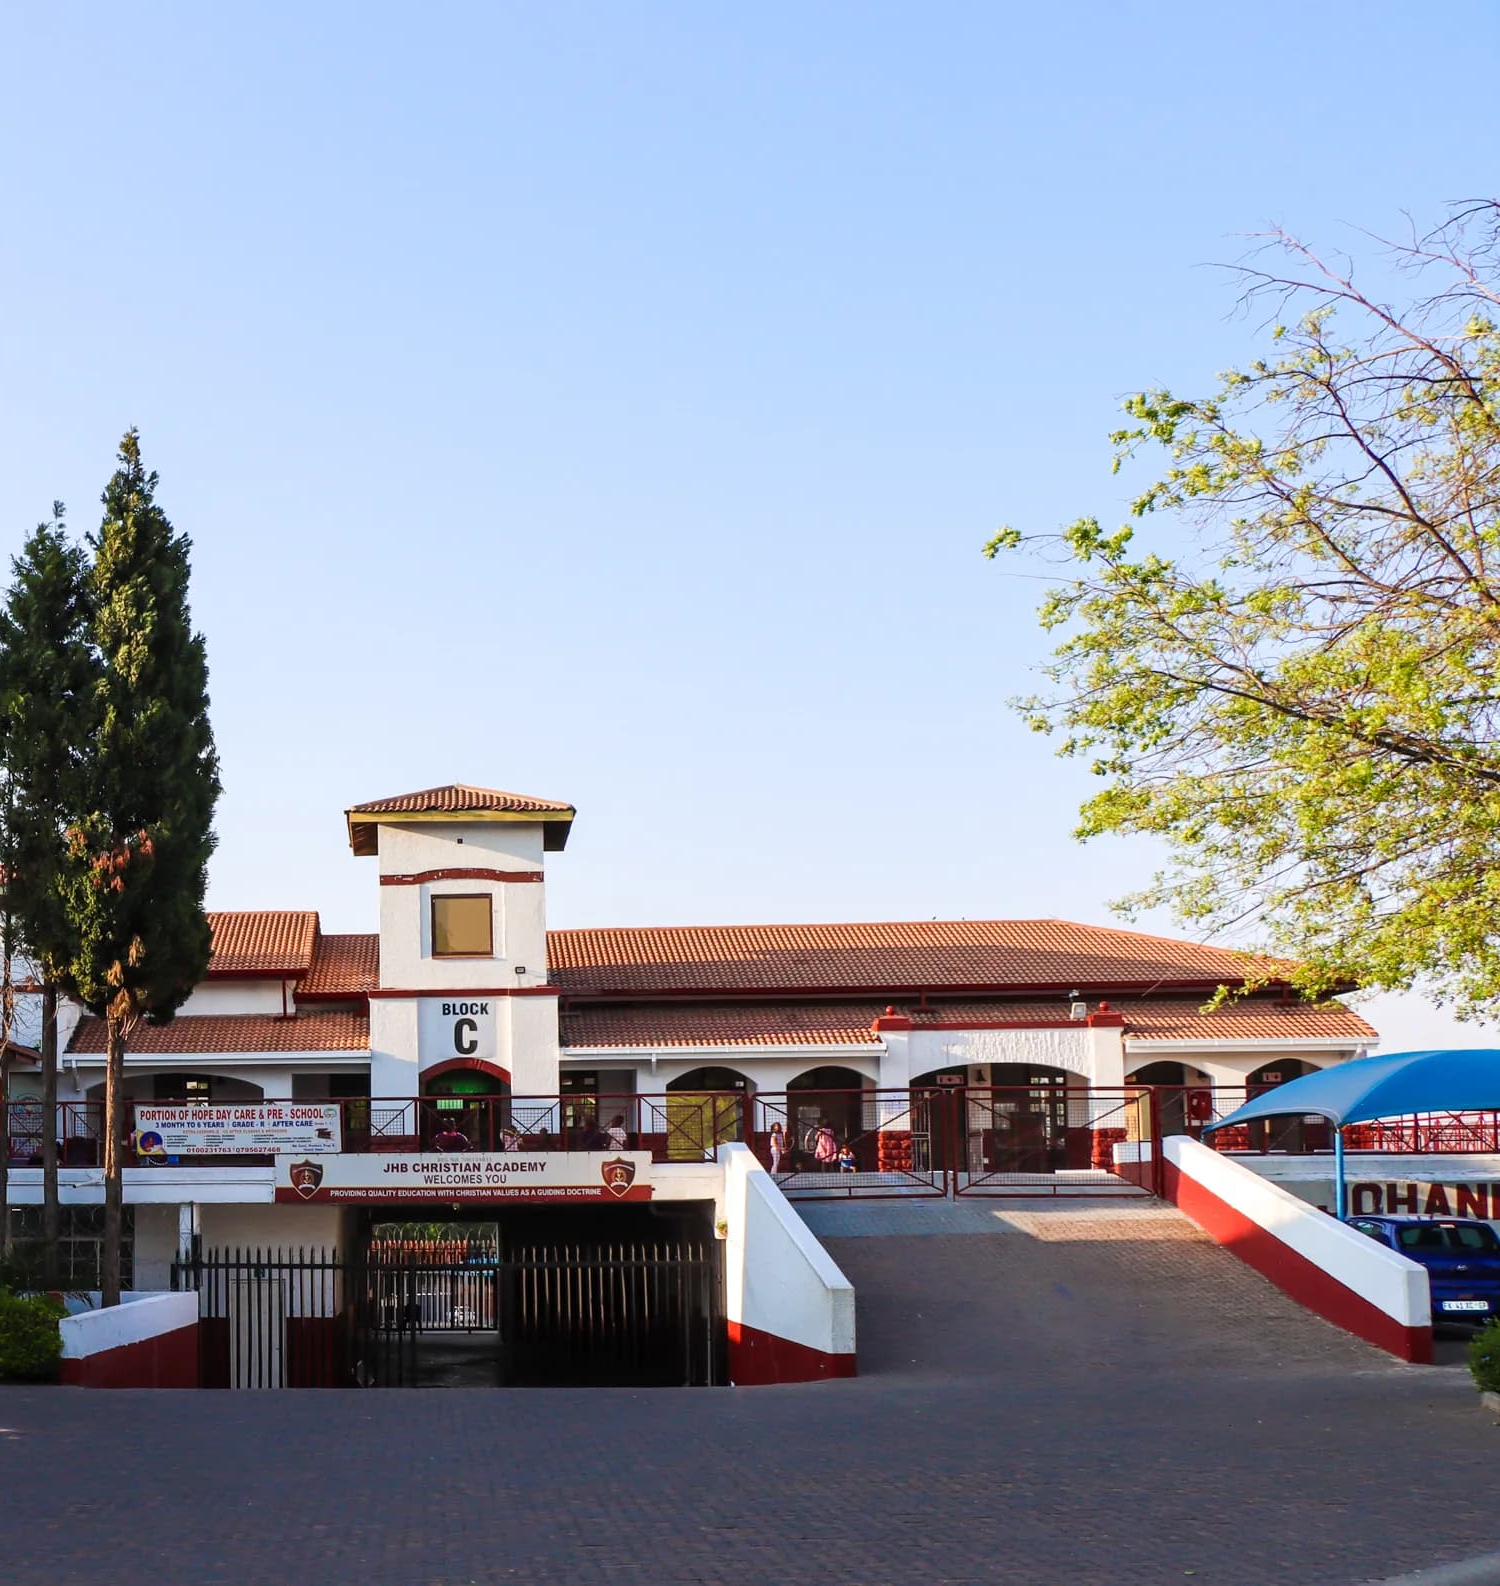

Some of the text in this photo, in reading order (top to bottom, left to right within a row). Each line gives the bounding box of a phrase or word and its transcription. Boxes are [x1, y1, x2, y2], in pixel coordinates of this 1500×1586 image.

[442, 1002, 489, 1016] BLOCK
[453, 1017, 478, 1055] C
[140, 1110, 177, 1121] PORTION
[179, 1110, 189, 1120] OF
[192, 1109, 214, 1120] HOPE
[216, 1109, 232, 1120] DAY
[234, 1109, 256, 1120] CARE
[258, 1109, 265, 1120] &
[267, 1108, 283, 1119] PRE
[290, 1108, 324, 1119] SCHOOL
[155, 1121, 160, 1129] 3
[161, 1121, 185, 1129] MONTH
[232, 1120, 254, 1128] GRADE
[272, 1120, 294, 1128] AFTER
[383, 1162, 547, 1173] JHB CHRISTIAN ACADEMY
[423, 1174, 507, 1185] WELCOMES YOU
[330, 1189, 367, 1197] PROVIDING
[368, 1189, 397, 1197] QUALITY
[398, 1189, 437, 1197] EDUCATION
[437, 1189, 454, 1197] WITH
[537, 1188, 565, 1196] GUIDING
[1317, 1183, 1500, 1220] OHAN
